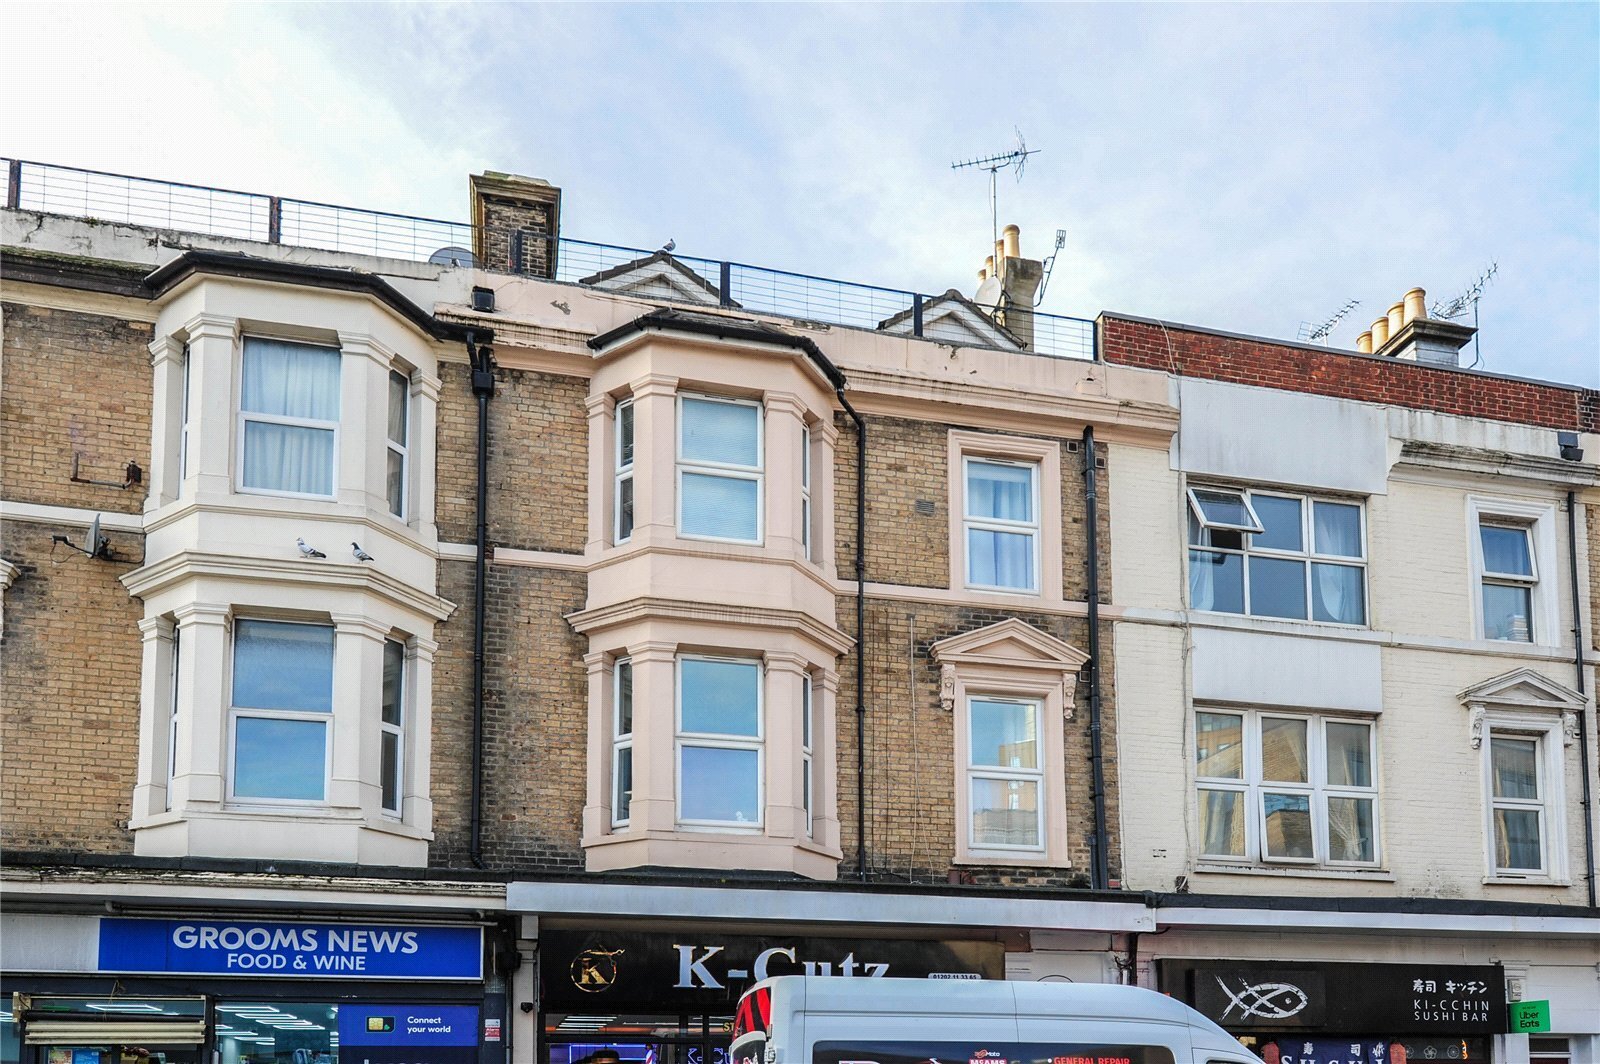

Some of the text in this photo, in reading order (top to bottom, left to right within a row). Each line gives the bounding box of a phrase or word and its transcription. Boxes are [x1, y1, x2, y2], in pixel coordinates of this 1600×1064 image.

[173, 925, 419, 954] GROOMS NEWS
[227, 953, 366, 971] FOOD & WINE
[1413, 978, 1488, 994] 寿司 キッチン
[1413, 999, 1490, 1011] KI-CCHIN
[407, 1016, 442, 1024] Connect
[1414, 1011, 1488, 1022] SUSHI BAR
[1519, 1011, 1539, 1019] Uber
[407, 1025, 451, 1034] your world
[1520, 1020, 1540, 1028] Eats
